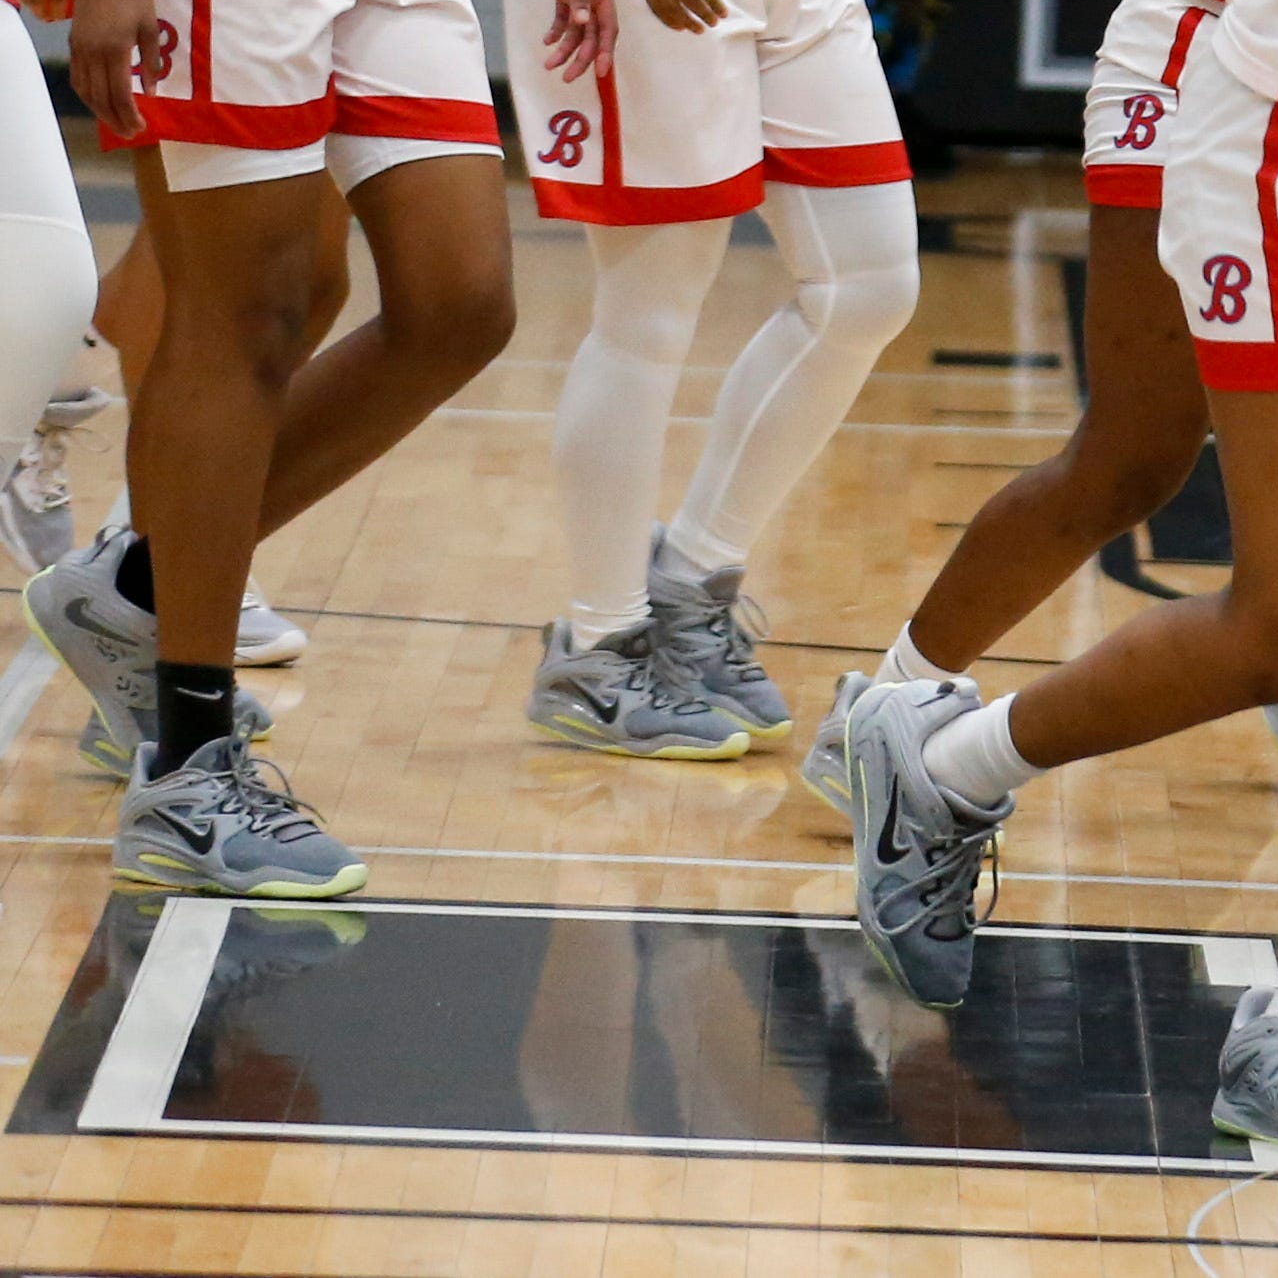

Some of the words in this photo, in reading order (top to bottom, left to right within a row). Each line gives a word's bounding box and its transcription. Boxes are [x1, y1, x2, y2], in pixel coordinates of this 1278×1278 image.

[537, 110, 590, 168] B
[1114, 94, 1165, 150] B
[1200, 254, 1252, 324] B
